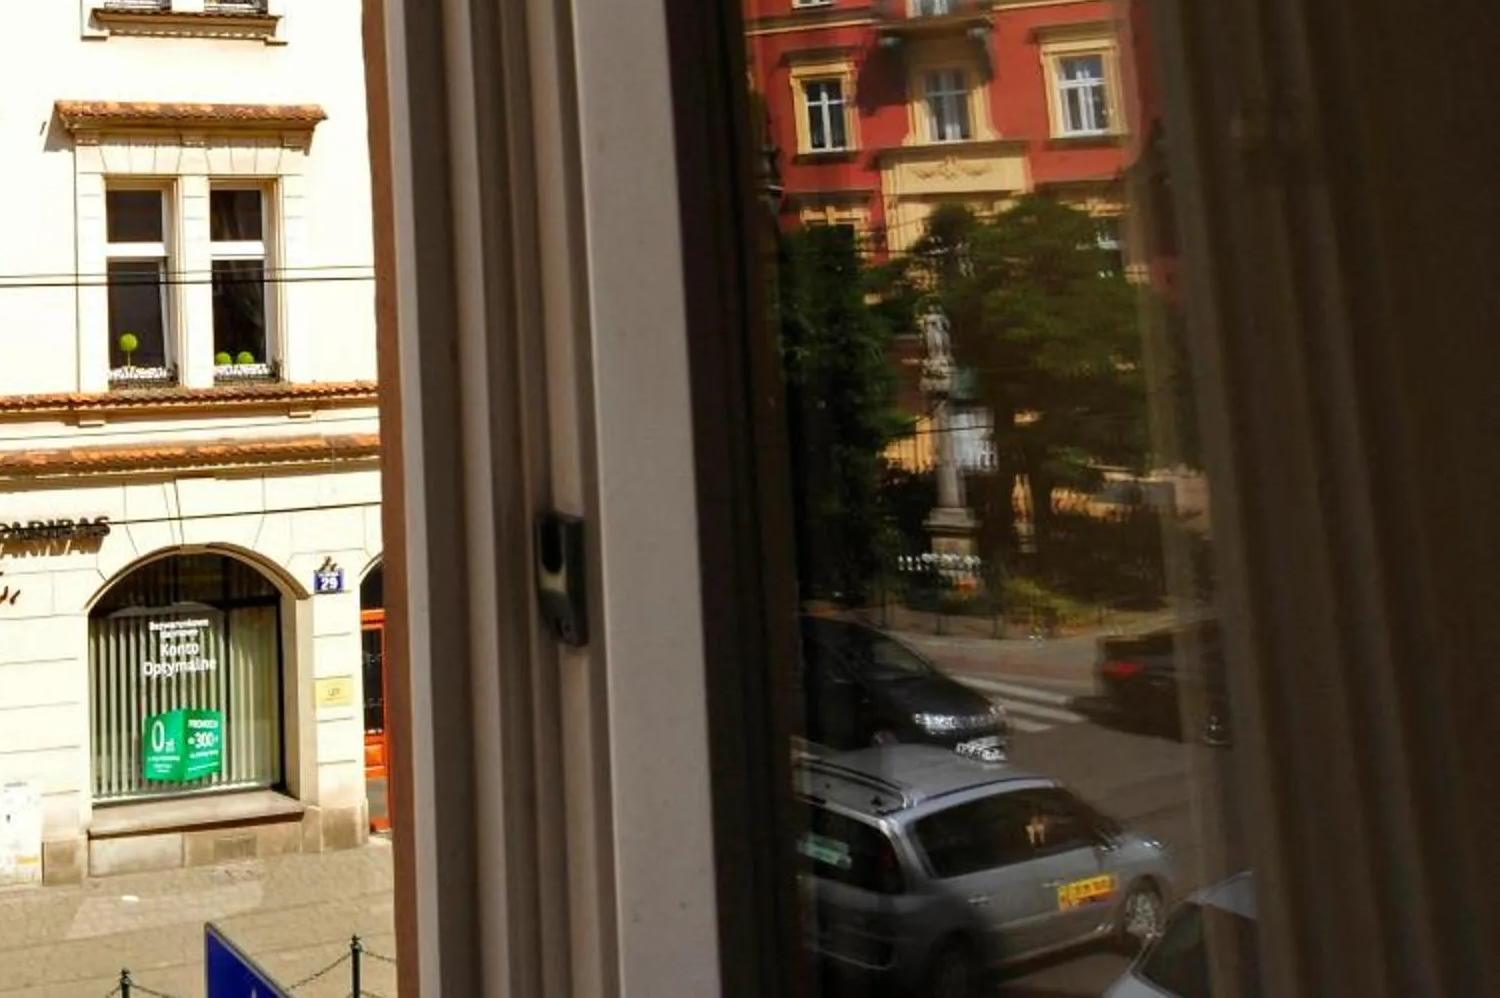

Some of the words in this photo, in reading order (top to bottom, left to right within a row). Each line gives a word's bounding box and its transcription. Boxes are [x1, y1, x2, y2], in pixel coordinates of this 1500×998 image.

[320, 577, 339, 591] 29
[160, 643, 199, 657] Konto
[143, 658, 217, 679] Optymalne
